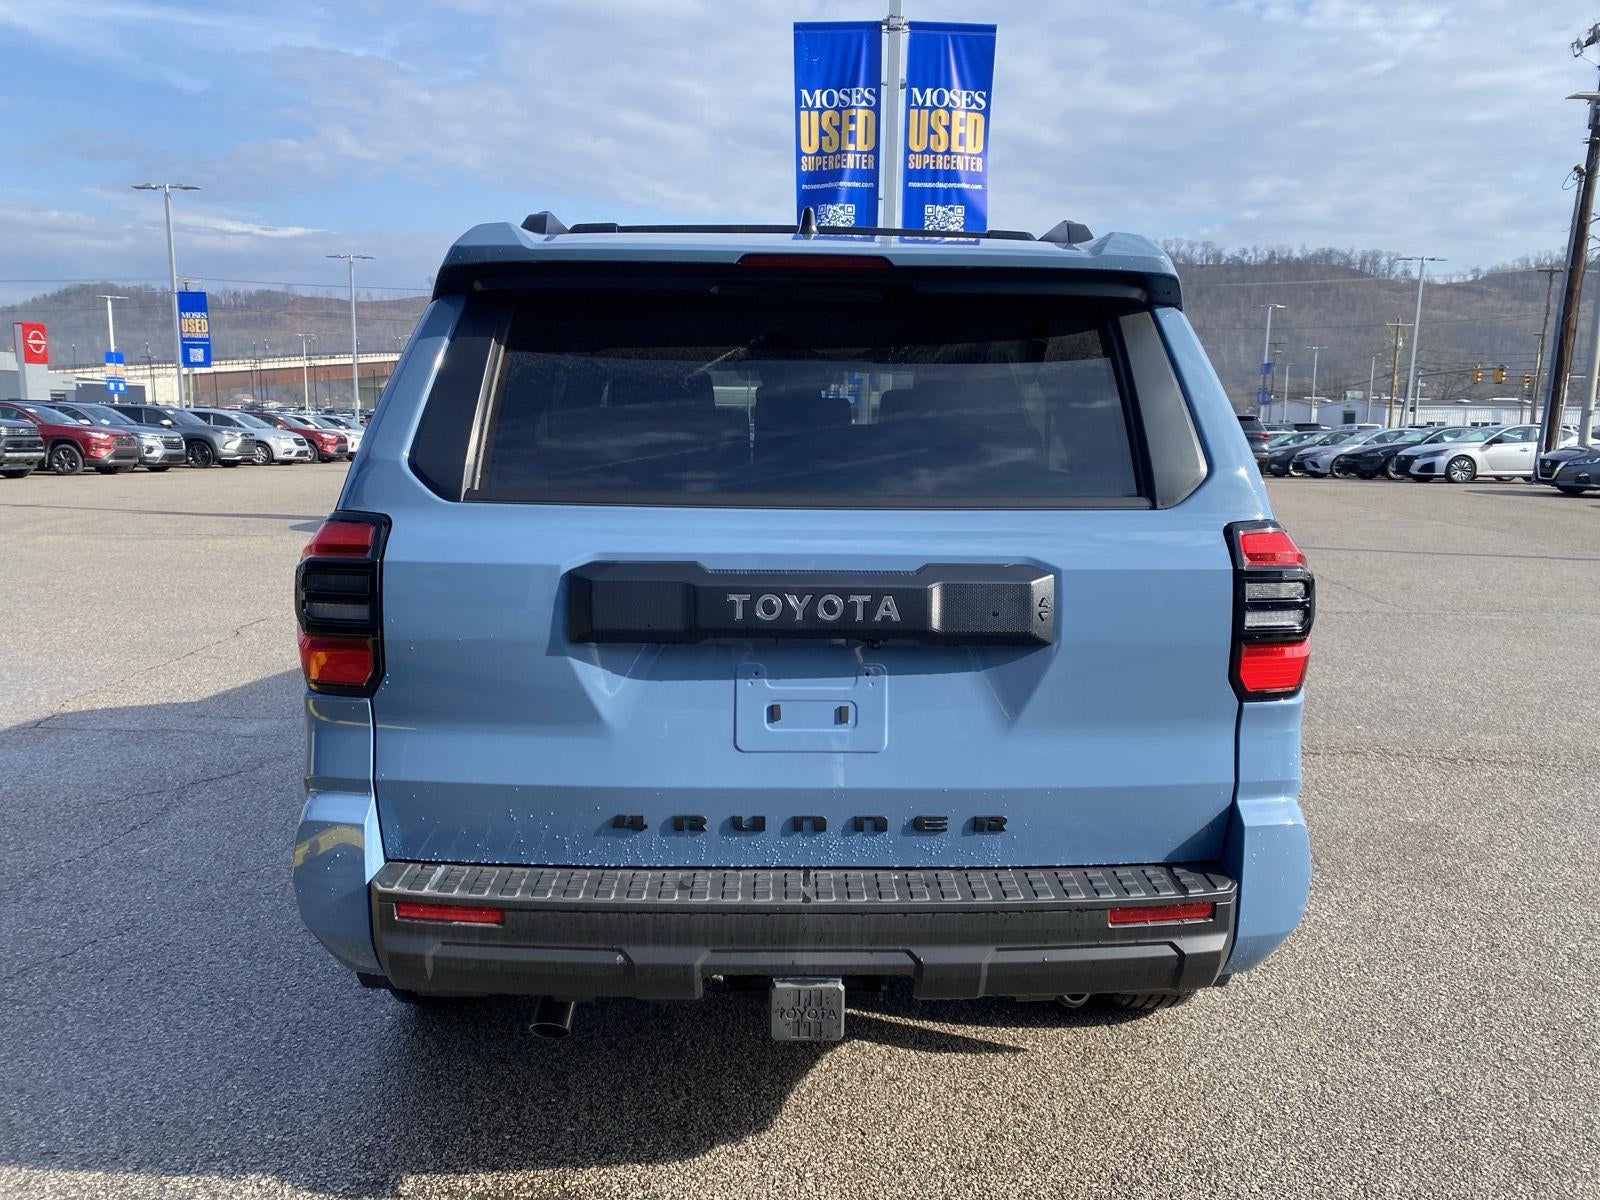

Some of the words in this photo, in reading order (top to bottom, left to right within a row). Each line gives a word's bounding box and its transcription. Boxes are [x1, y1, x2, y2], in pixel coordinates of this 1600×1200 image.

[800, 88, 876, 108] MOSES
[911, 88, 987, 109] MOSES
[800, 109, 876, 153] USED
[908, 109, 986, 154] USED
[801, 154, 875, 172] SUPERCENTER
[908, 154, 983, 172] SUPERCENTER
[802, 181, 874, 190] mosesusedsupercenter.com
[908, 181, 983, 190] mosesusedsupercenter.com
[181, 319, 208, 332] USED
[727, 593, 901, 622] TOYOTA
[612, 814, 1008, 833] 4RUNNER
[775, 1006, 837, 1020] TOYOTA
